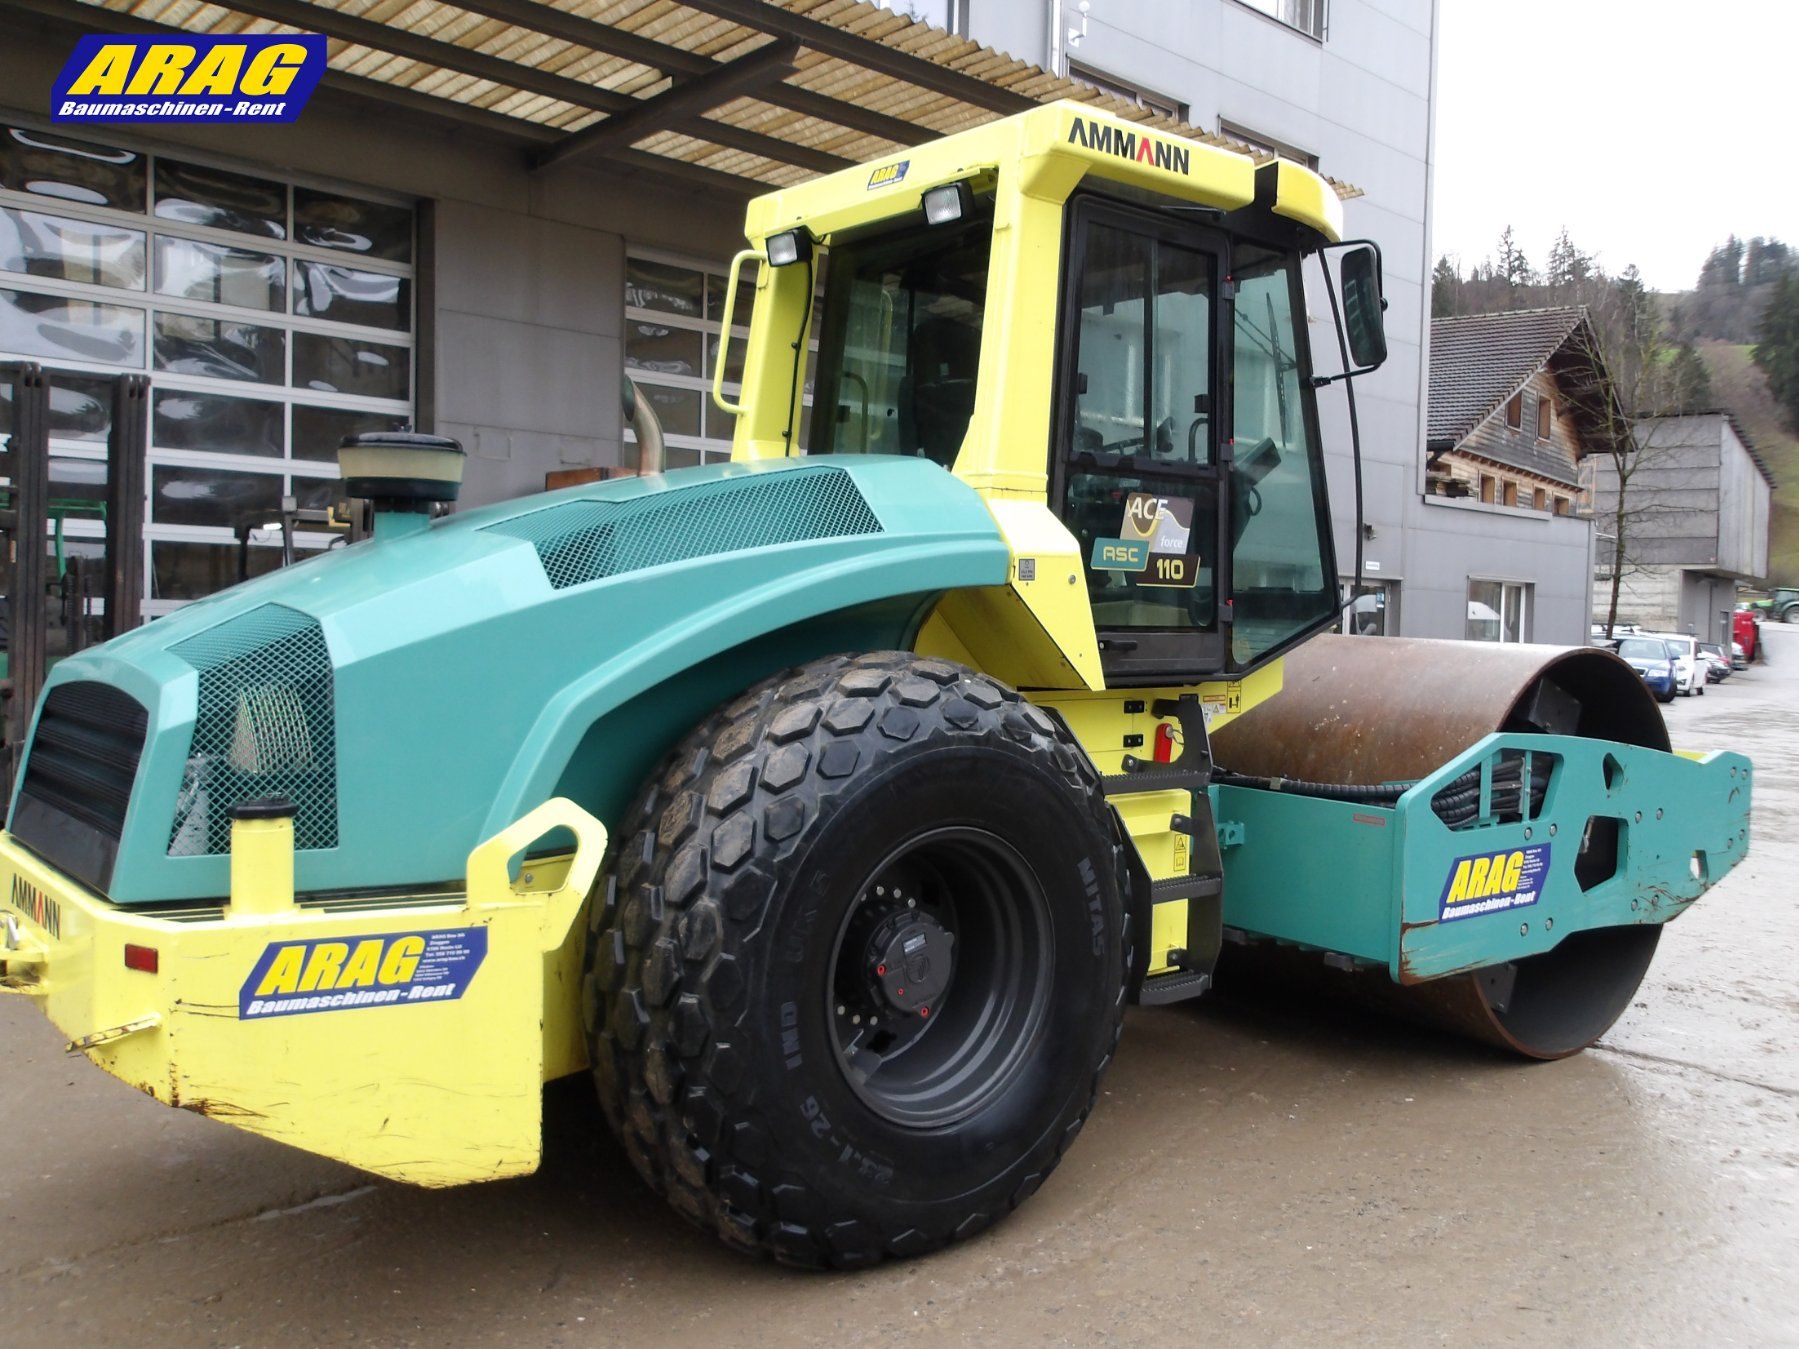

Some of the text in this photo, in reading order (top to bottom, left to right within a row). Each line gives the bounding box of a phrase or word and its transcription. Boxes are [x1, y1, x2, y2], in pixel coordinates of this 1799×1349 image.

[1068, 117, 1189, 175] AMMANN
[1128, 497, 1169, 520] ACE
[1103, 546, 1139, 562] ASC
[1161, 536, 1183, 548] force
[1156, 558, 1184, 580] 110
[1446, 851, 1524, 903] ARAG
[11, 873, 61, 940] AMMANN
[254, 936, 425, 996] ARAG
[246, 983, 457, 1015] Baumaschinen-Rent
